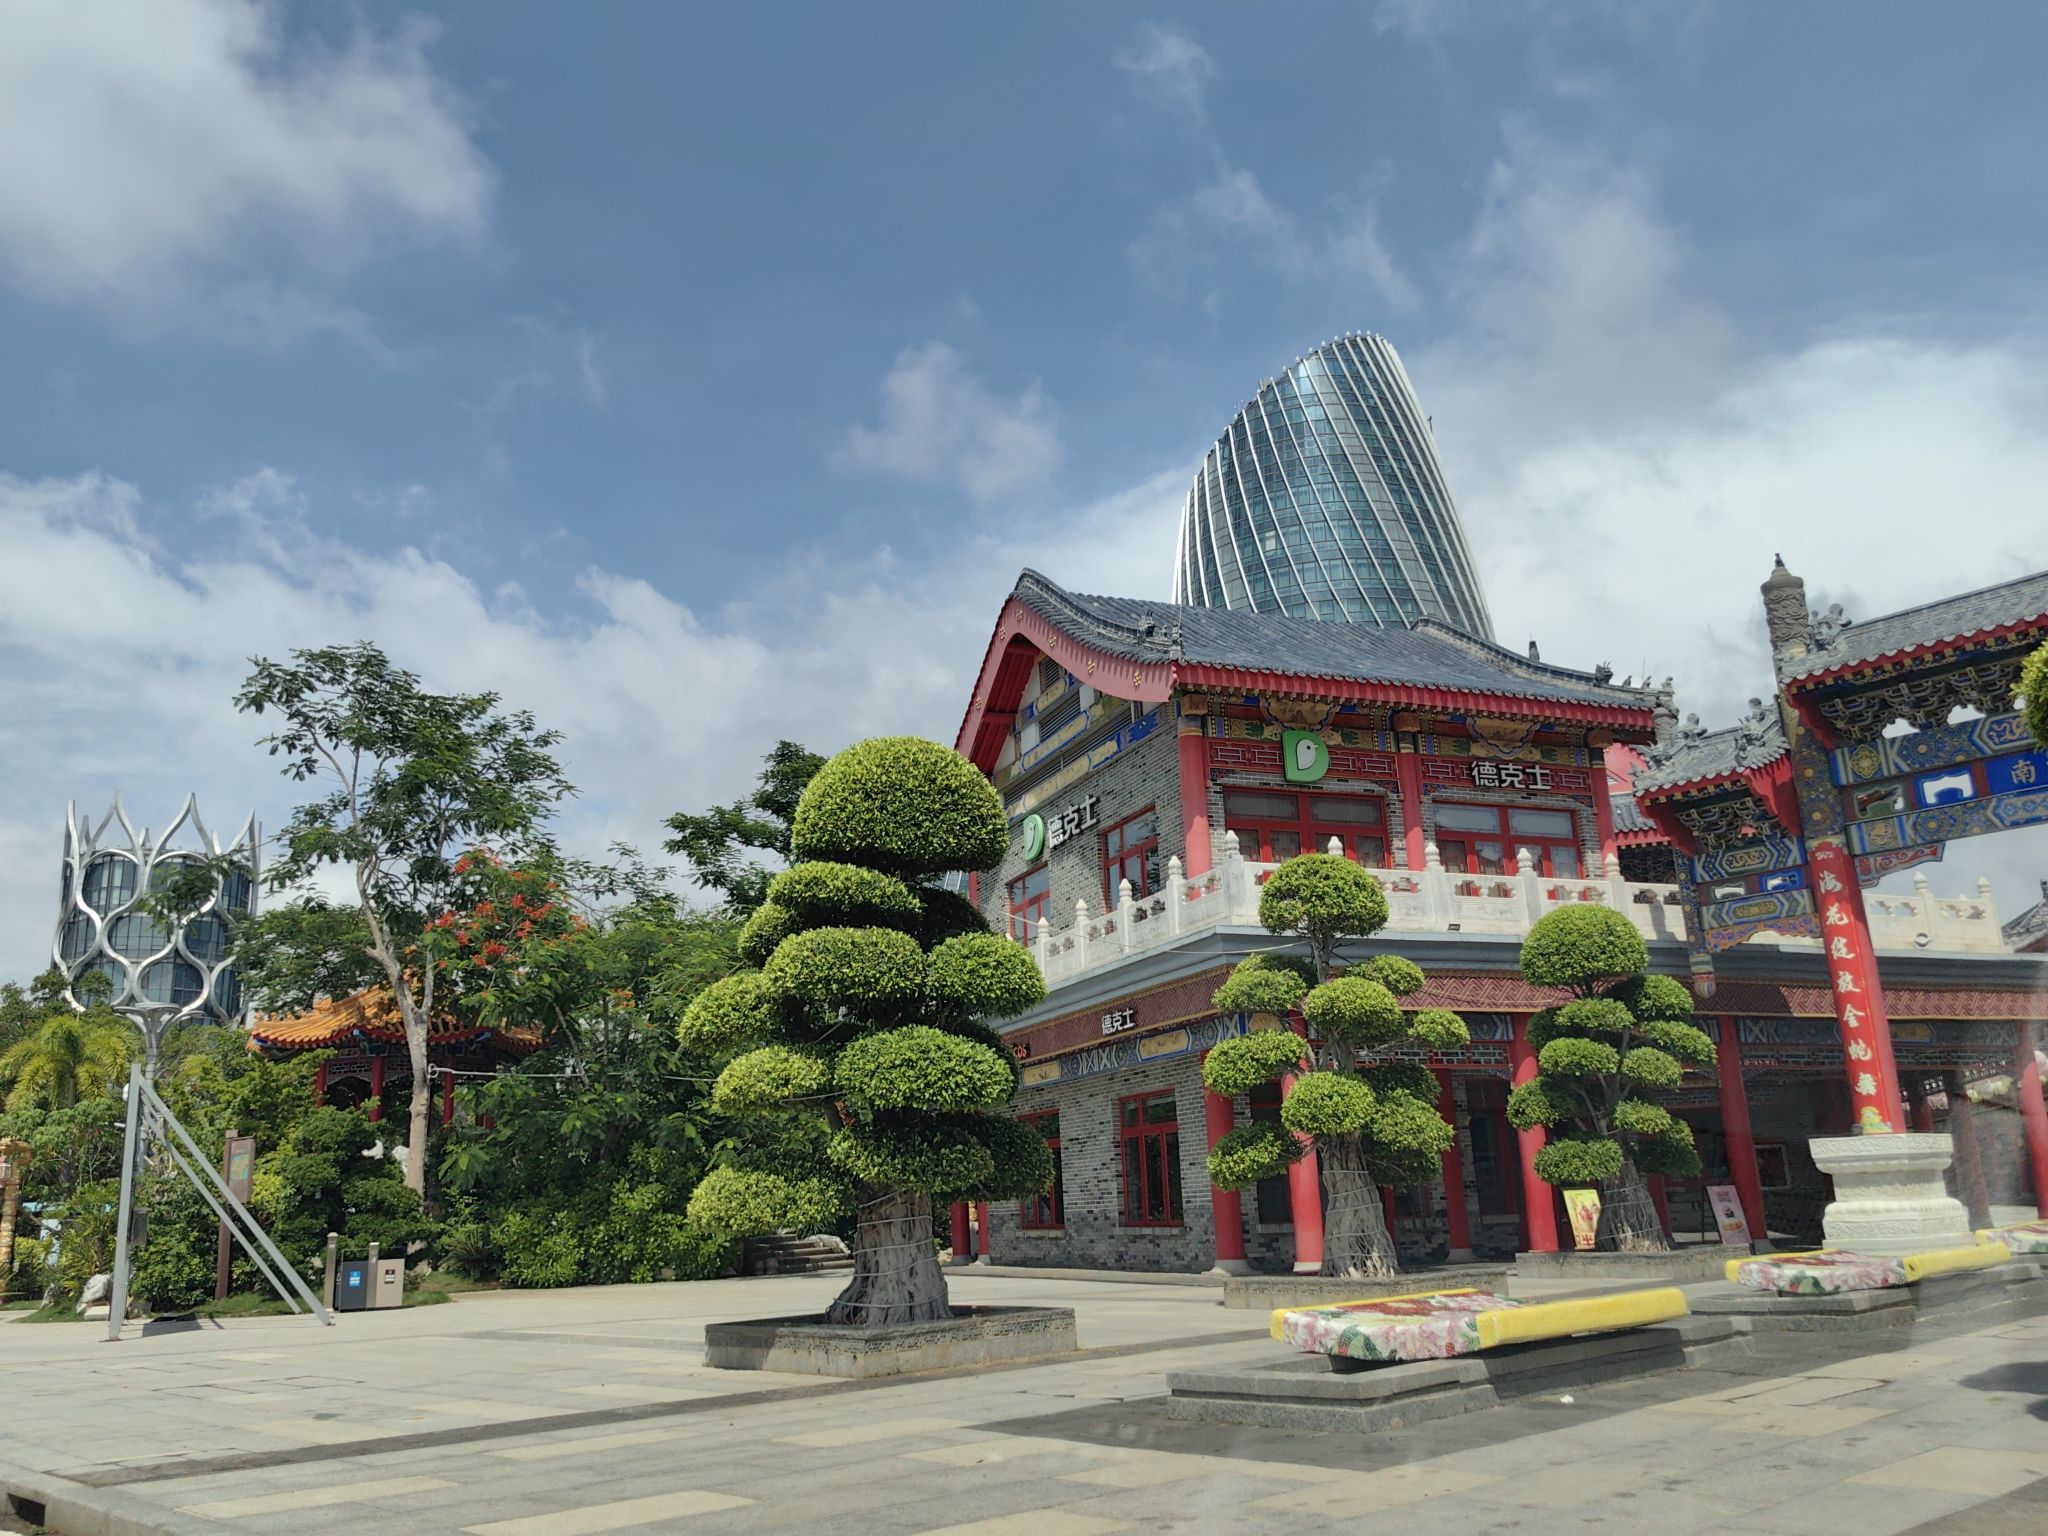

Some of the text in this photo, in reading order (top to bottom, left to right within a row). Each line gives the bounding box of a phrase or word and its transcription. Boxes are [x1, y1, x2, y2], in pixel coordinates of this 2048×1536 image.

[1471, 760, 1552, 790] 德克士
[1047, 794, 1097, 849] 德克士
[1101, 1007, 1136, 1036] 德克士
